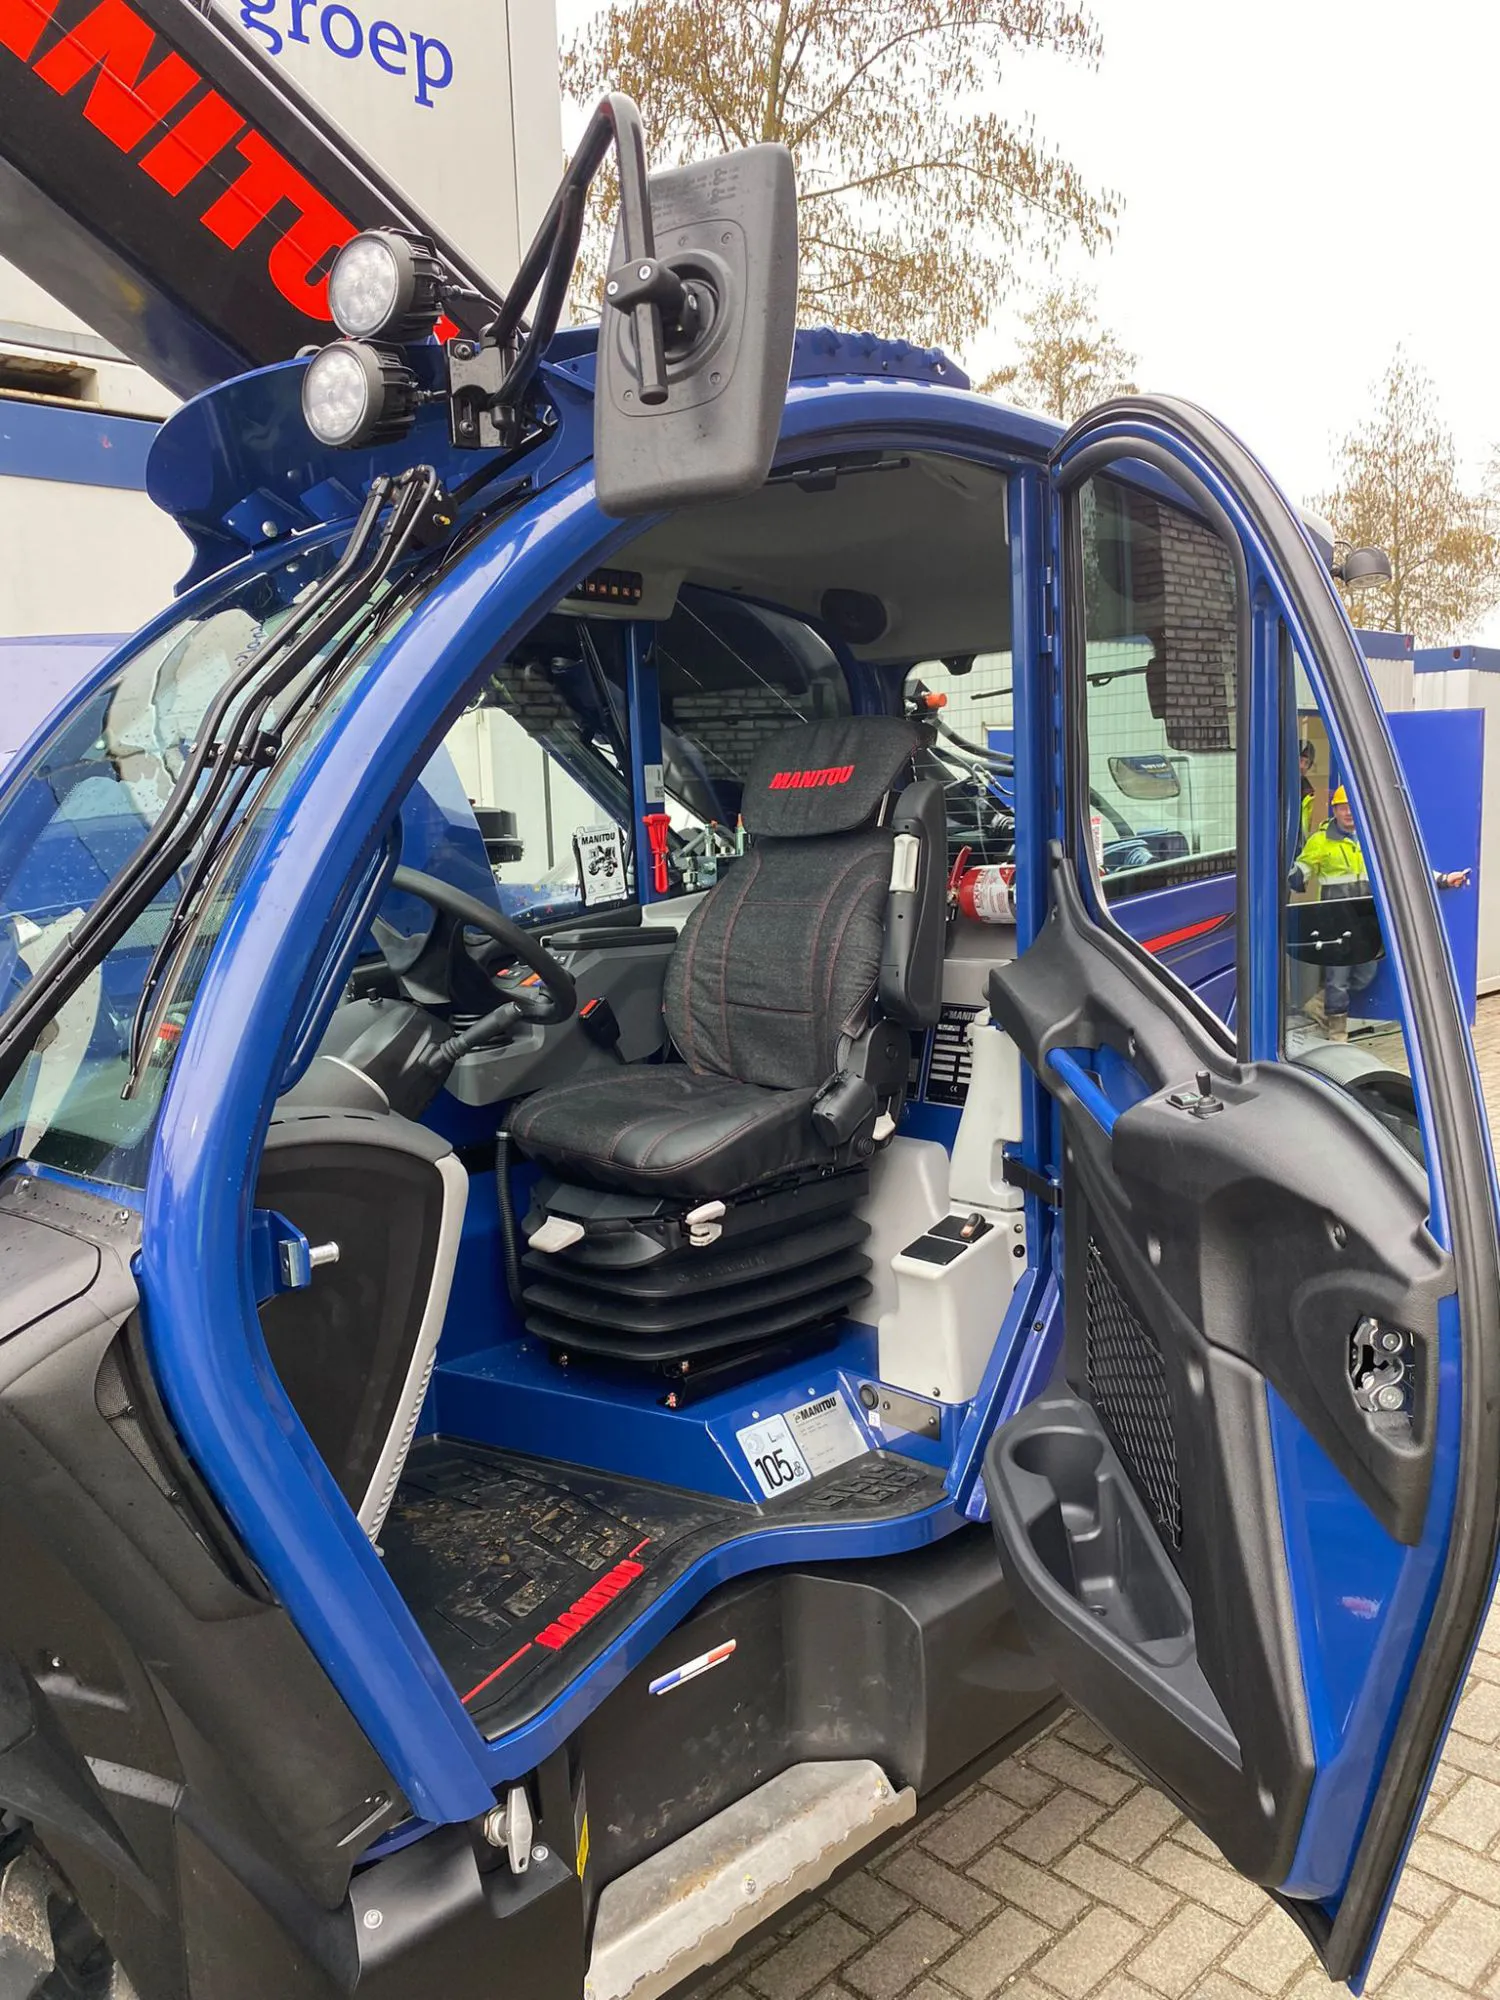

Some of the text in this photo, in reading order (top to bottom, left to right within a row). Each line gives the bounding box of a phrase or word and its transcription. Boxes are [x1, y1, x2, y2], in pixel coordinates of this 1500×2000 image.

[240, 0, 454, 108] groep
[768, 764, 855, 789] MANITOU
[581, 832, 616, 845] MANITOU
[800, 1397, 837, 1420] MANITOU
[755, 1448, 795, 1490] 105
[534, 1559, 645, 1650] MANITOU
